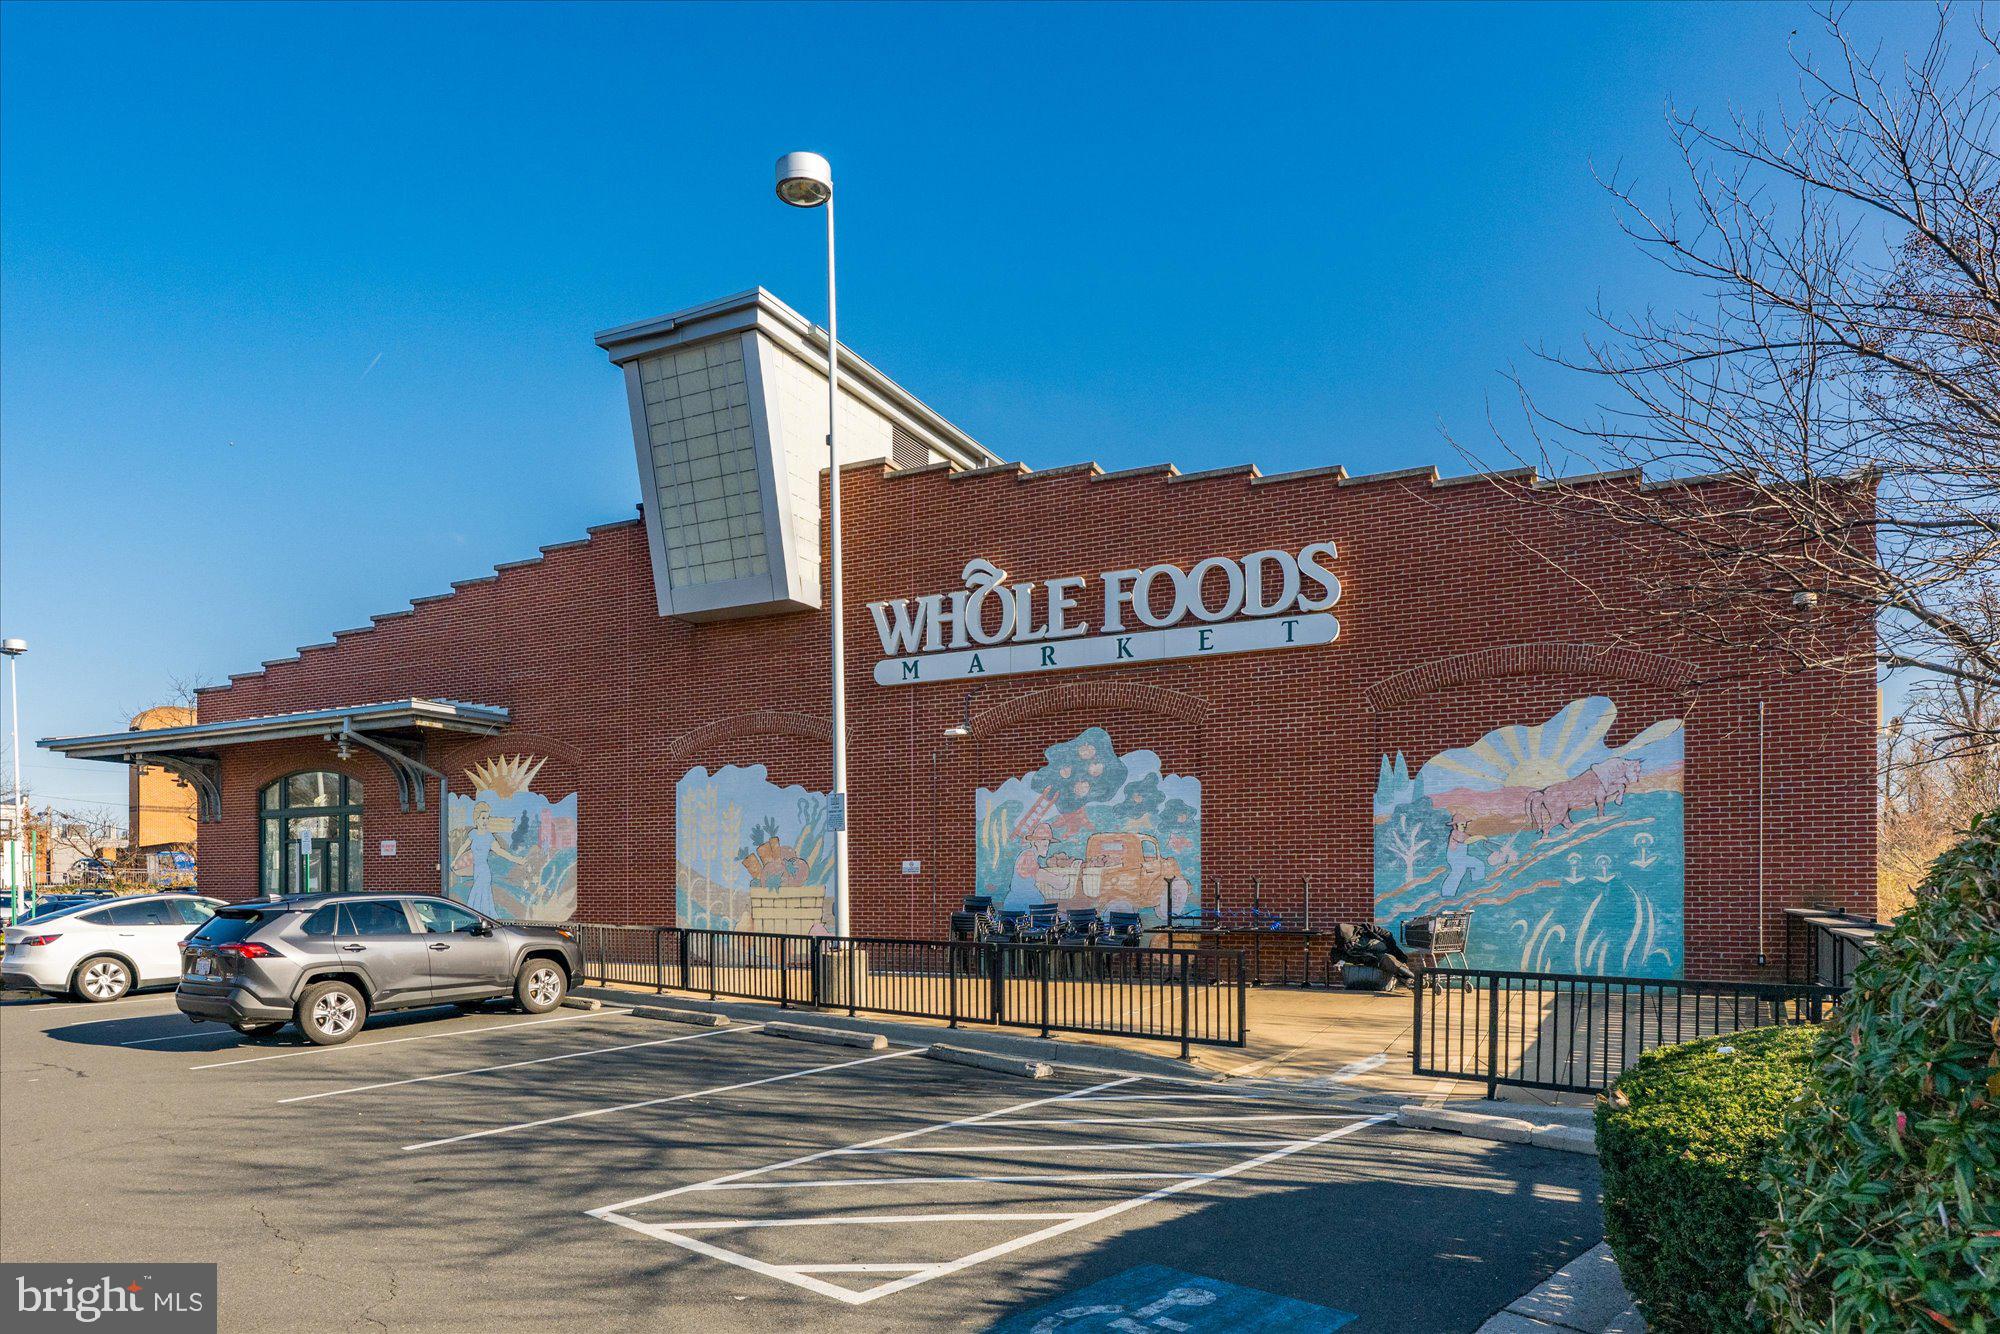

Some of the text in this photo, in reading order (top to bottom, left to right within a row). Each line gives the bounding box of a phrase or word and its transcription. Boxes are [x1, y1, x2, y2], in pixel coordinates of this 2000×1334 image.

[866, 540, 1342, 656] WHOLE FOODS
[902, 619, 1299, 681] MARKET
